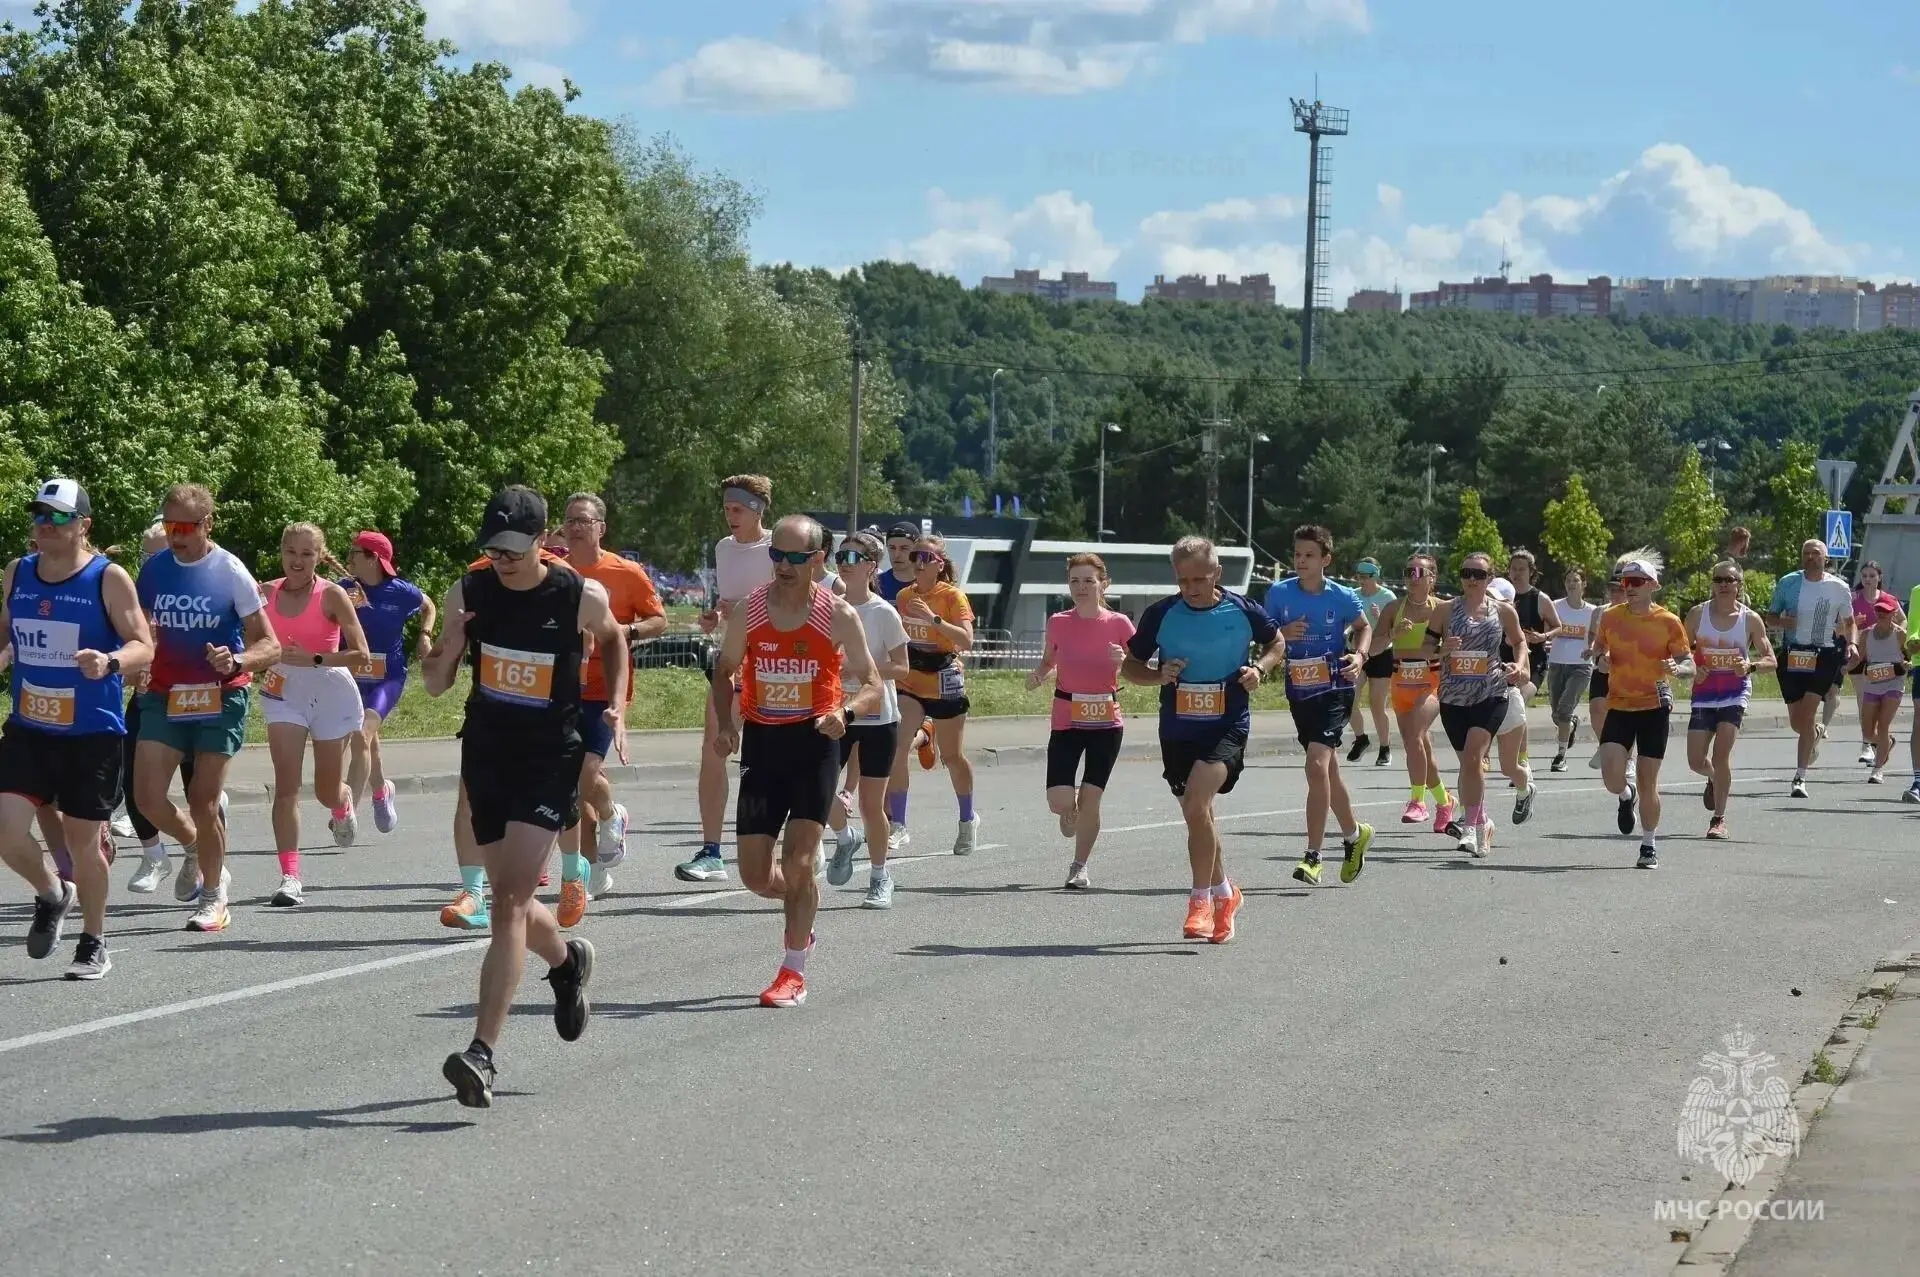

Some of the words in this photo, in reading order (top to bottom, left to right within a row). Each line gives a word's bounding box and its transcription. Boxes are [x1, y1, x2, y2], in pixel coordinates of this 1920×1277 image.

[154, 594, 212, 613] КРОСС
[48, 650, 58, 661] of
[1711, 655, 1734, 667] 314
[1794, 656, 1810, 666] 107
[1456, 658, 1480, 670] 297
[493, 660, 537, 688] 165
[1295, 666, 1320, 680] 322
[1401, 668, 1424, 680] 442
[176, 690, 211, 706] 444
[764, 684, 801, 702] 224
[26, 694, 62, 716] 393
[1185, 692, 1215, 709] 156
[1080, 703, 1107, 717] 303
